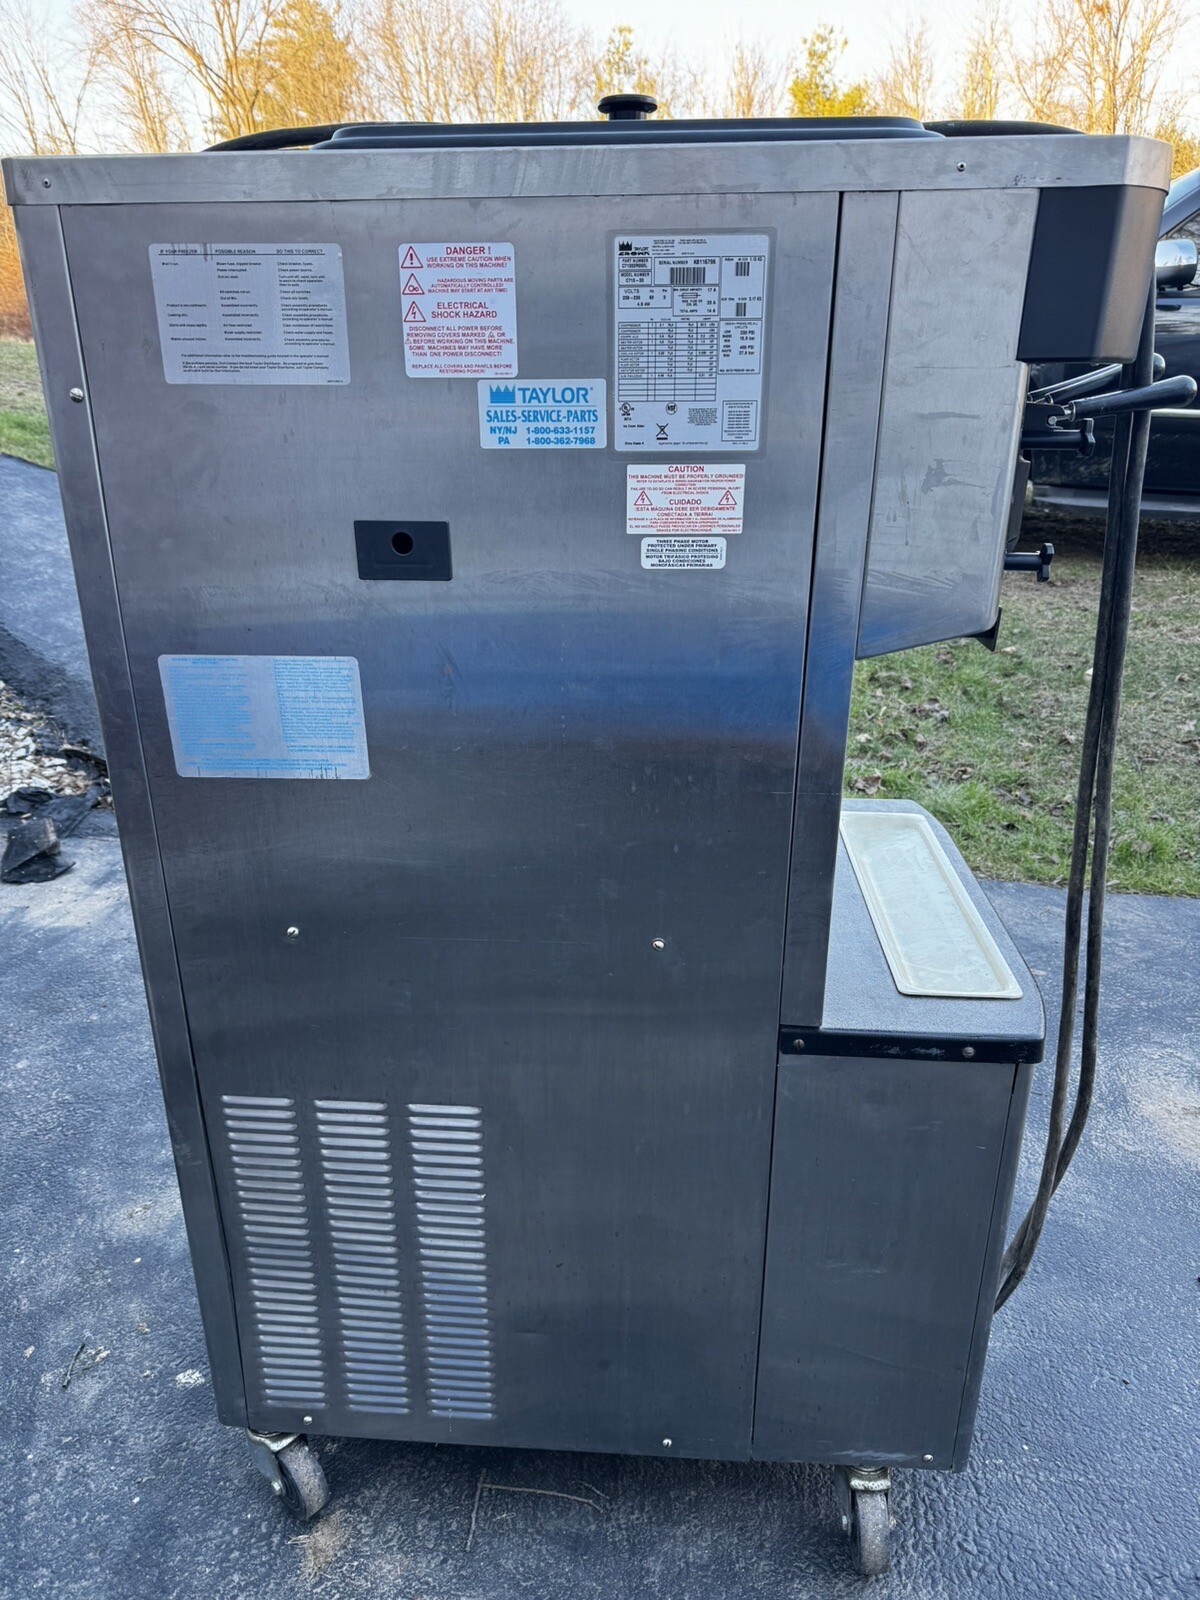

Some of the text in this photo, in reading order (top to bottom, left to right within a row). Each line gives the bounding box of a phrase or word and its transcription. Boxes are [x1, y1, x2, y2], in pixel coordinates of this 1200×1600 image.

[446, 246, 491, 255] DANGER !
[518, 387, 589, 403] TAYLOR
[486, 410, 598, 422] SALES-SERVICE-PARTS
